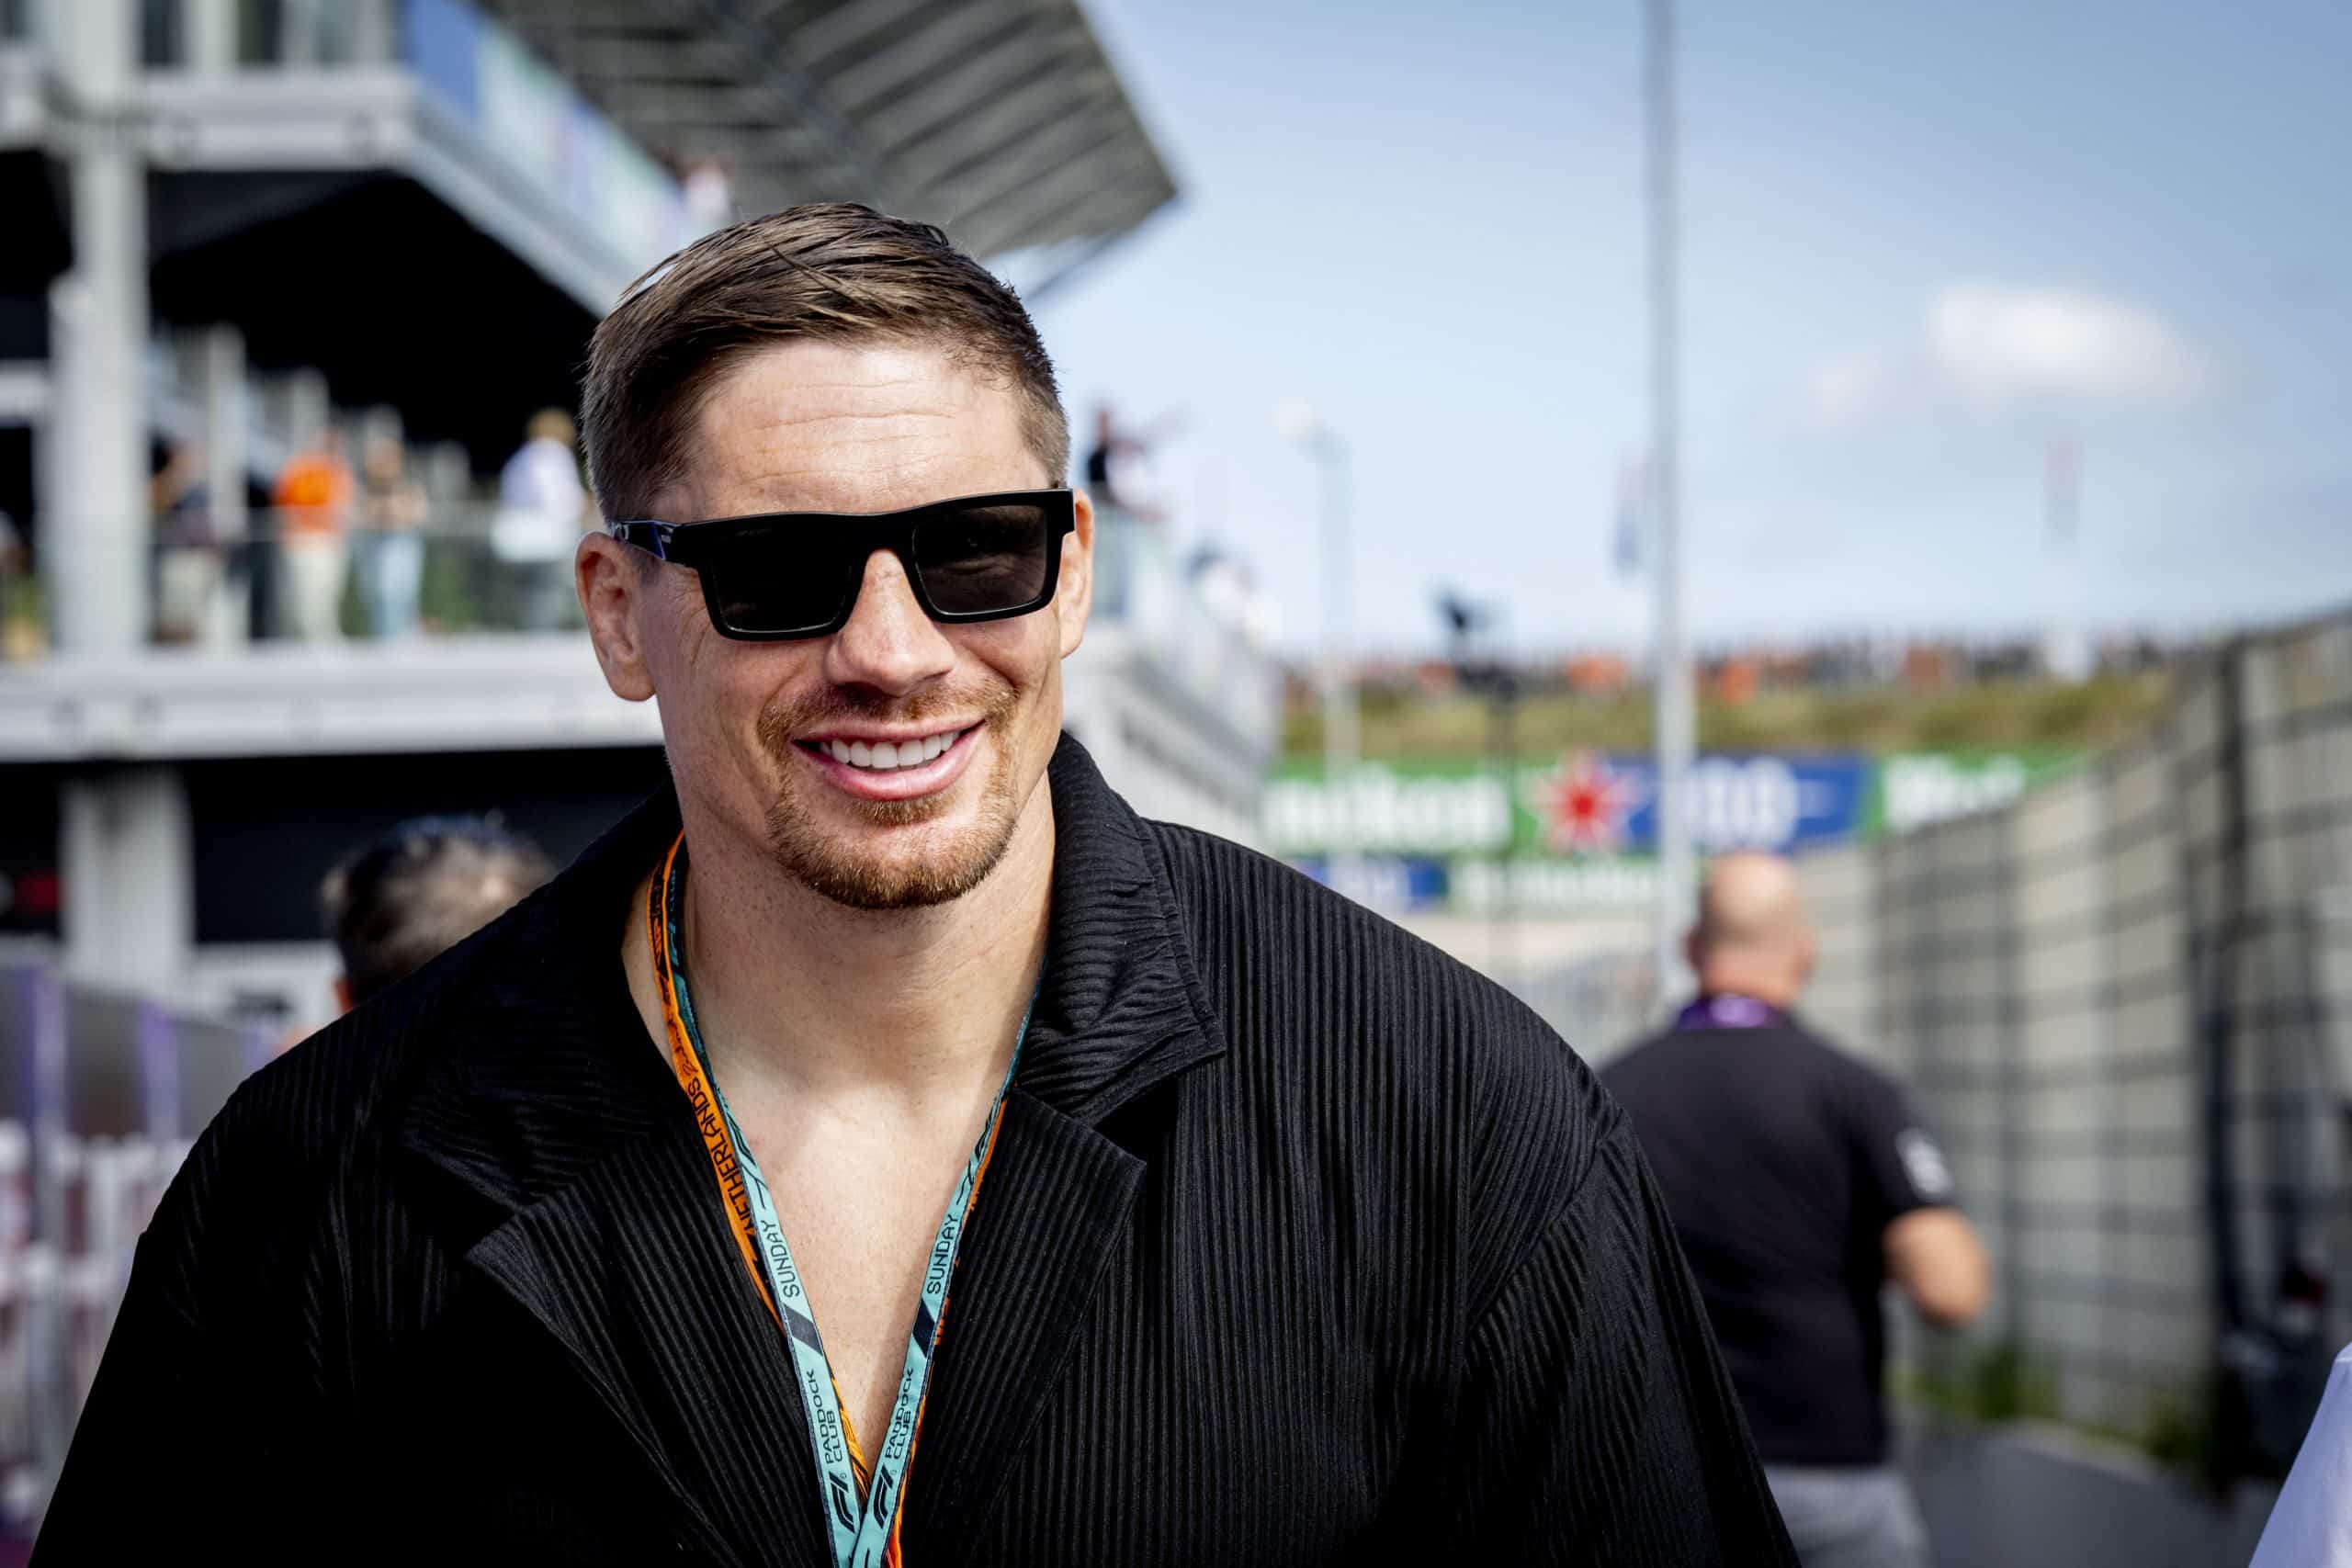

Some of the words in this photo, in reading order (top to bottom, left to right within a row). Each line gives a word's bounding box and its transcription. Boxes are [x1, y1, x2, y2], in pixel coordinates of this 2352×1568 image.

[761, 1220, 799, 1299] SUNDAY
[927, 1213, 958, 1294] SUNDAY
[807, 1369, 835, 1463] PADDOCK
[827, 1410, 842, 1462] CLUB
[885, 1368, 913, 1459] PADDOCK
[894, 1411, 911, 1459] CLUB
